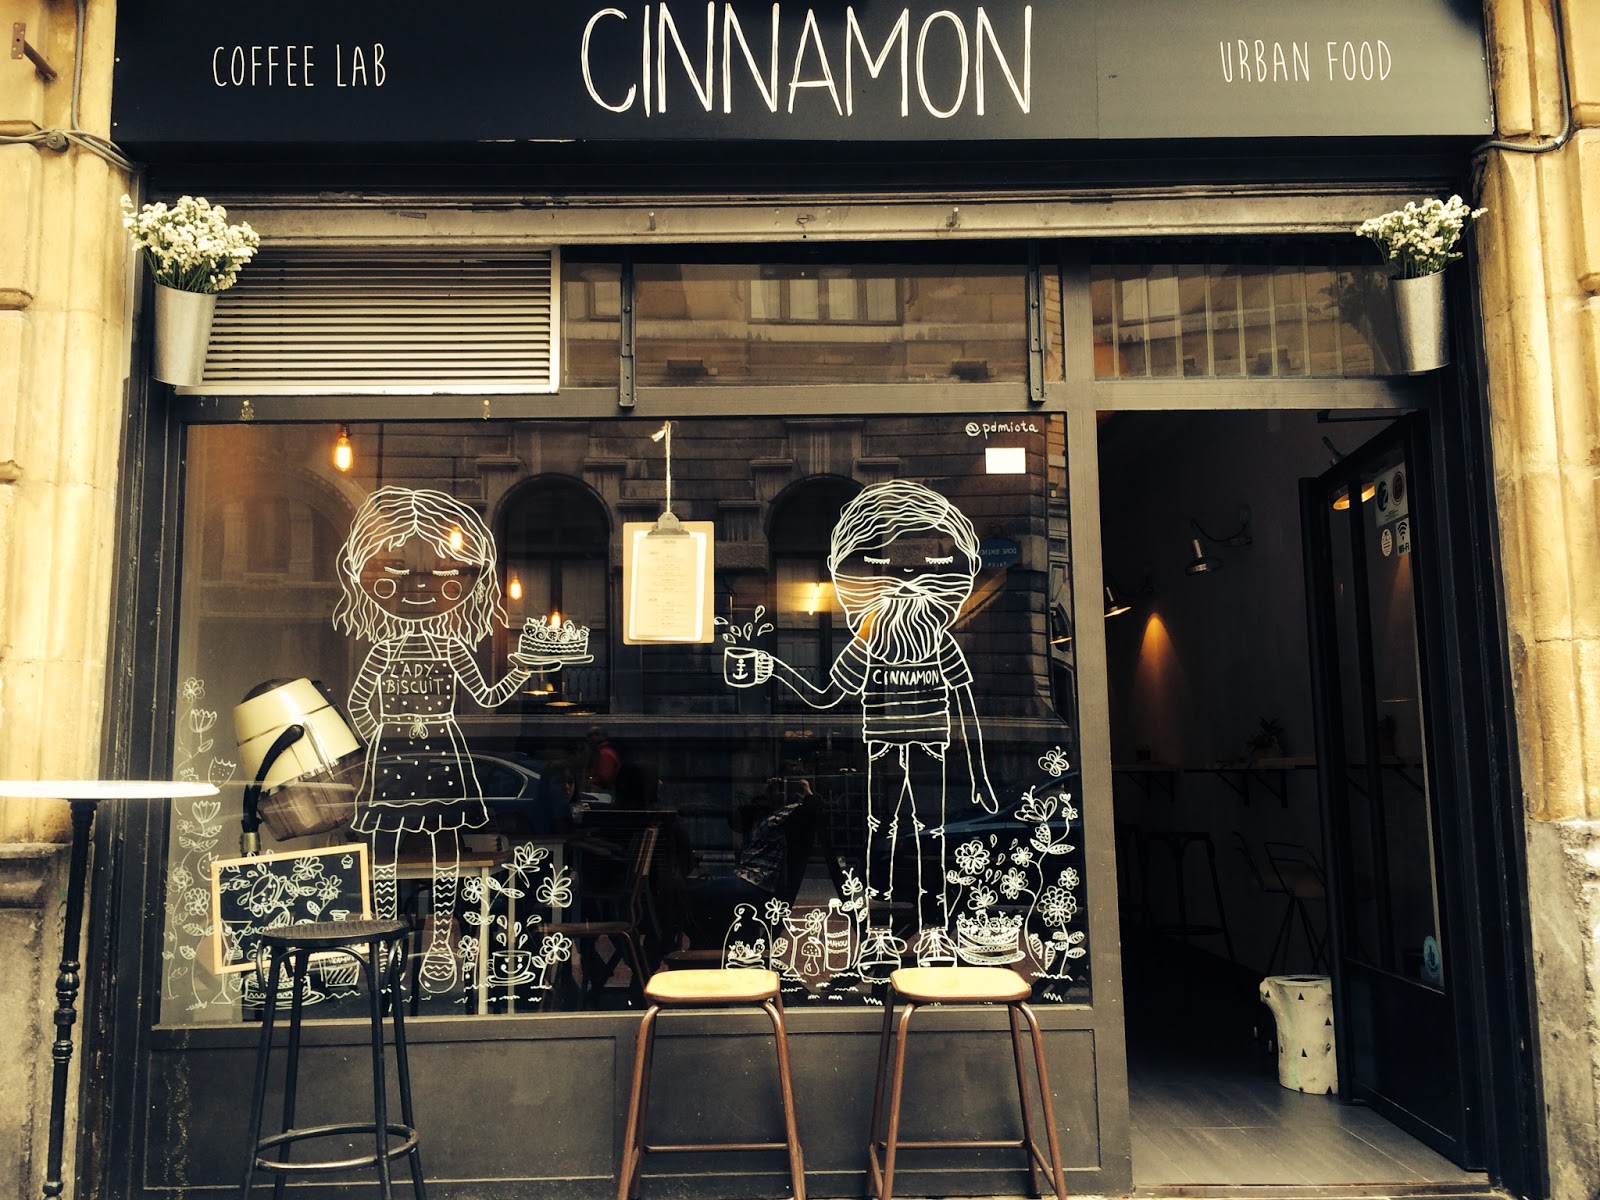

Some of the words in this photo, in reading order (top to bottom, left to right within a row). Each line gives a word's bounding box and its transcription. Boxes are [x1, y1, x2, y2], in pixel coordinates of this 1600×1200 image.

[212, 45, 315, 87] COFFEE
[336, 43, 386, 87] LAB
[580, 2, 1032, 118] CINNAMON
[1219, 40, 1310, 83] URBAN
[1326, 39, 1392, 82] FOOD
[390, 663, 435, 678] LADY
[872, 669, 940, 686] CINNAMON
[828, 939, 848, 948] MAHOU
